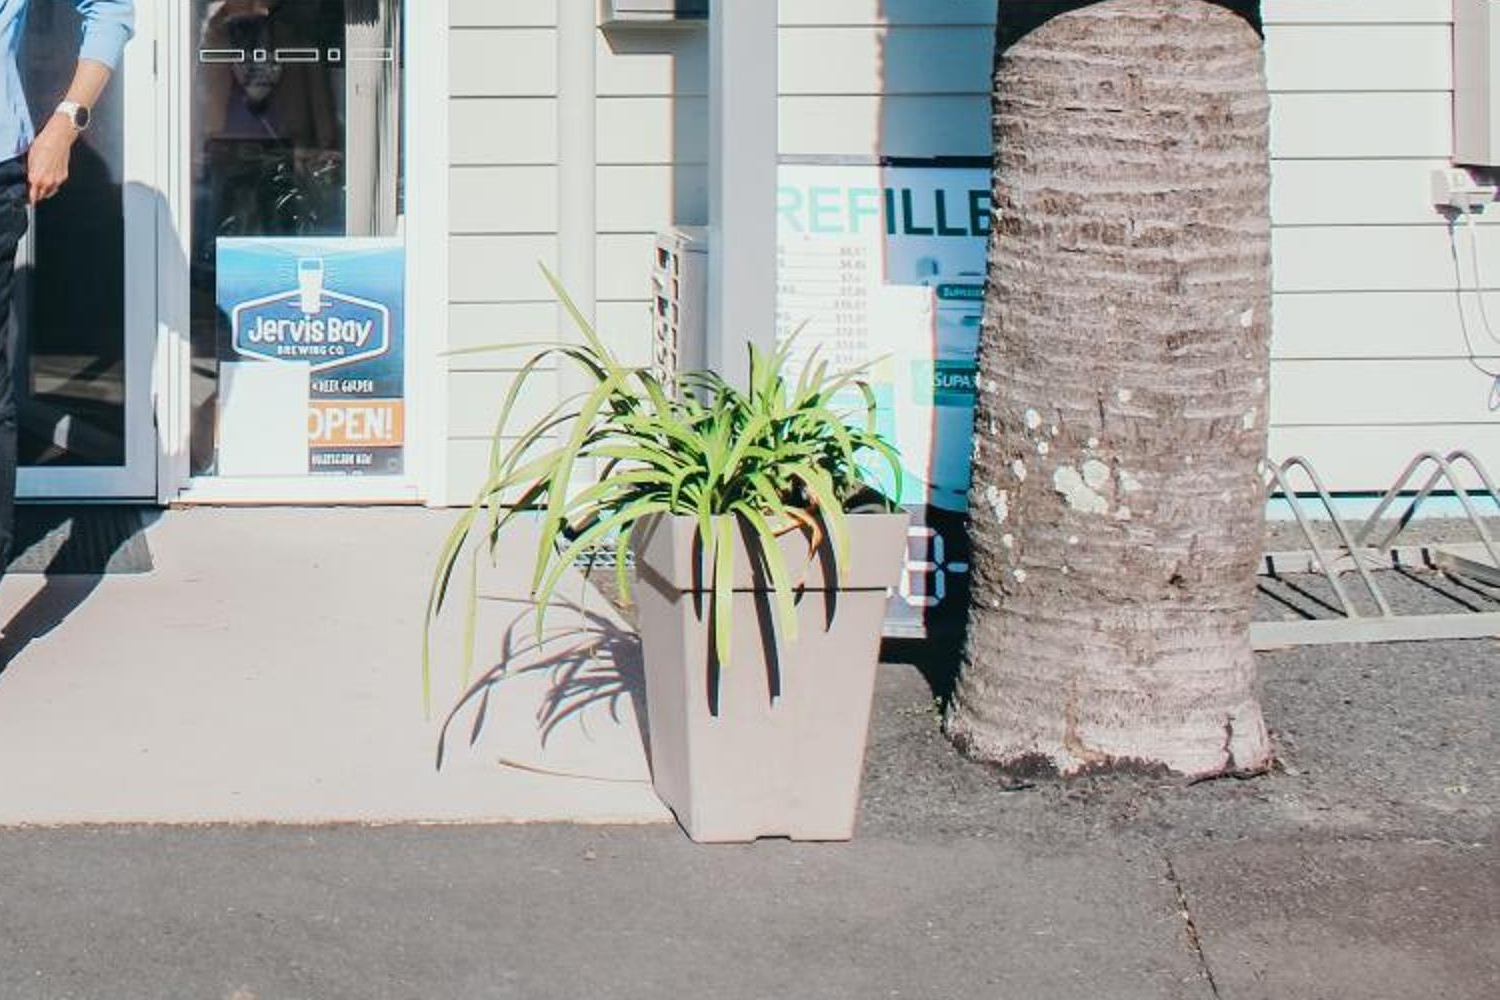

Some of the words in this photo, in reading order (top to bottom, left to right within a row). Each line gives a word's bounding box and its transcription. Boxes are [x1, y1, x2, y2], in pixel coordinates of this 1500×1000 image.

[248, 315, 325, 344] Jervis
[327, 316, 373, 348] Bay
[276, 344, 327, 356] BREWING
[932, 371, 976, 389] SUPA
[308, 407, 394, 441] OPEN!
